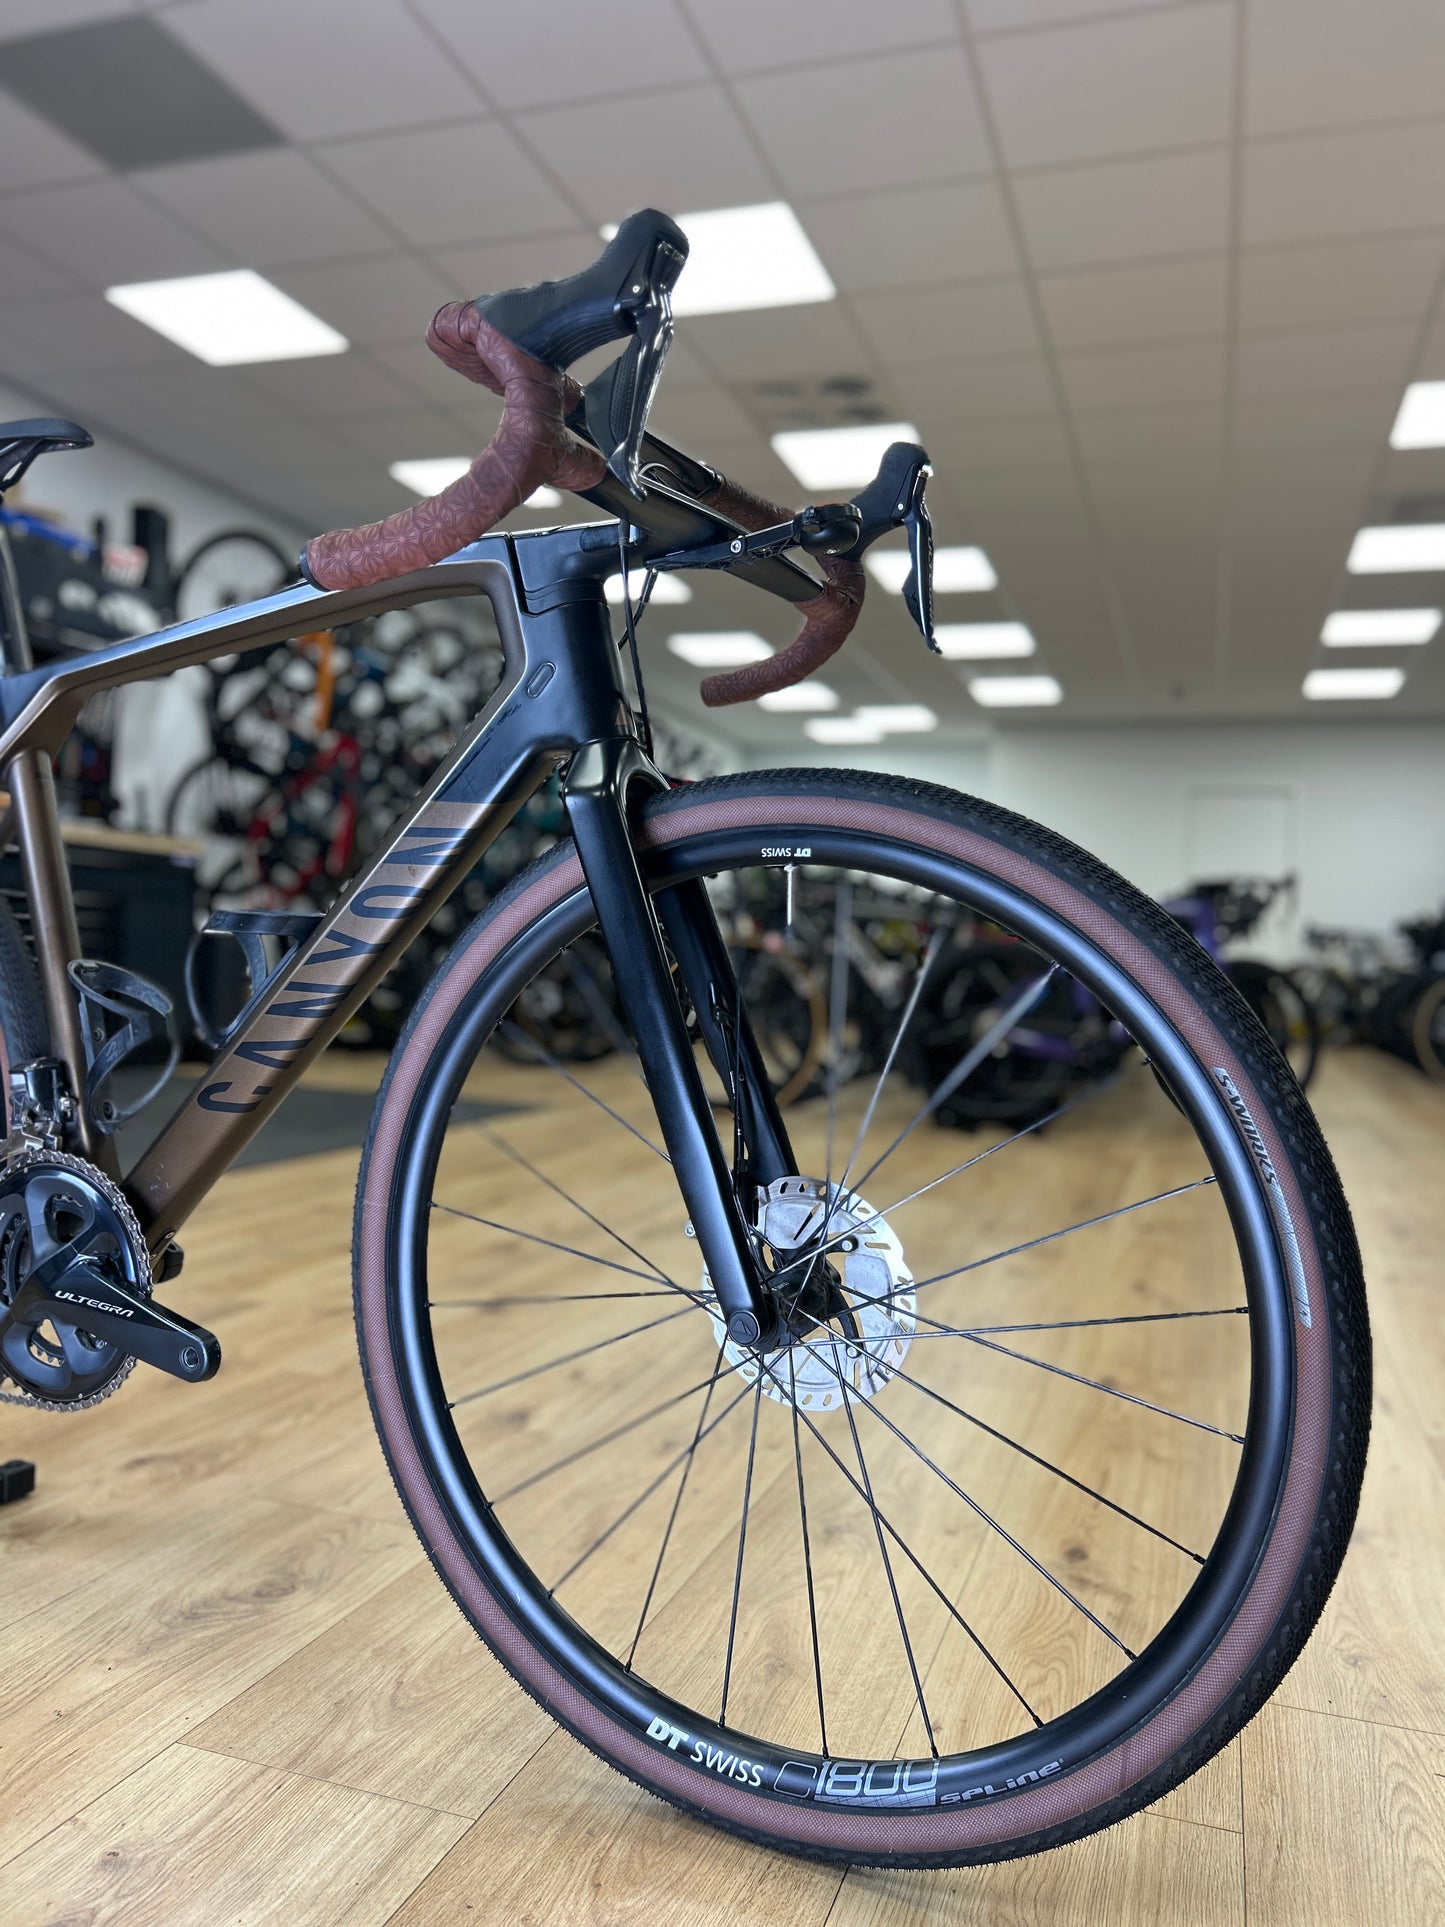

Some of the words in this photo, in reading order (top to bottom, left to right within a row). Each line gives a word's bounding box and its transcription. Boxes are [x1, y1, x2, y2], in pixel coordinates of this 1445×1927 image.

[761, 847, 791, 858] SWISS
[794, 848, 812, 857] DT
[197, 826, 477, 1114] CANYON
[1214, 1074, 1277, 1185] S-WORKS
[54, 1290, 135, 1318] ULTEGRA
[646, 1716, 690, 1750] DT
[690, 1741, 764, 1787] SWISS
